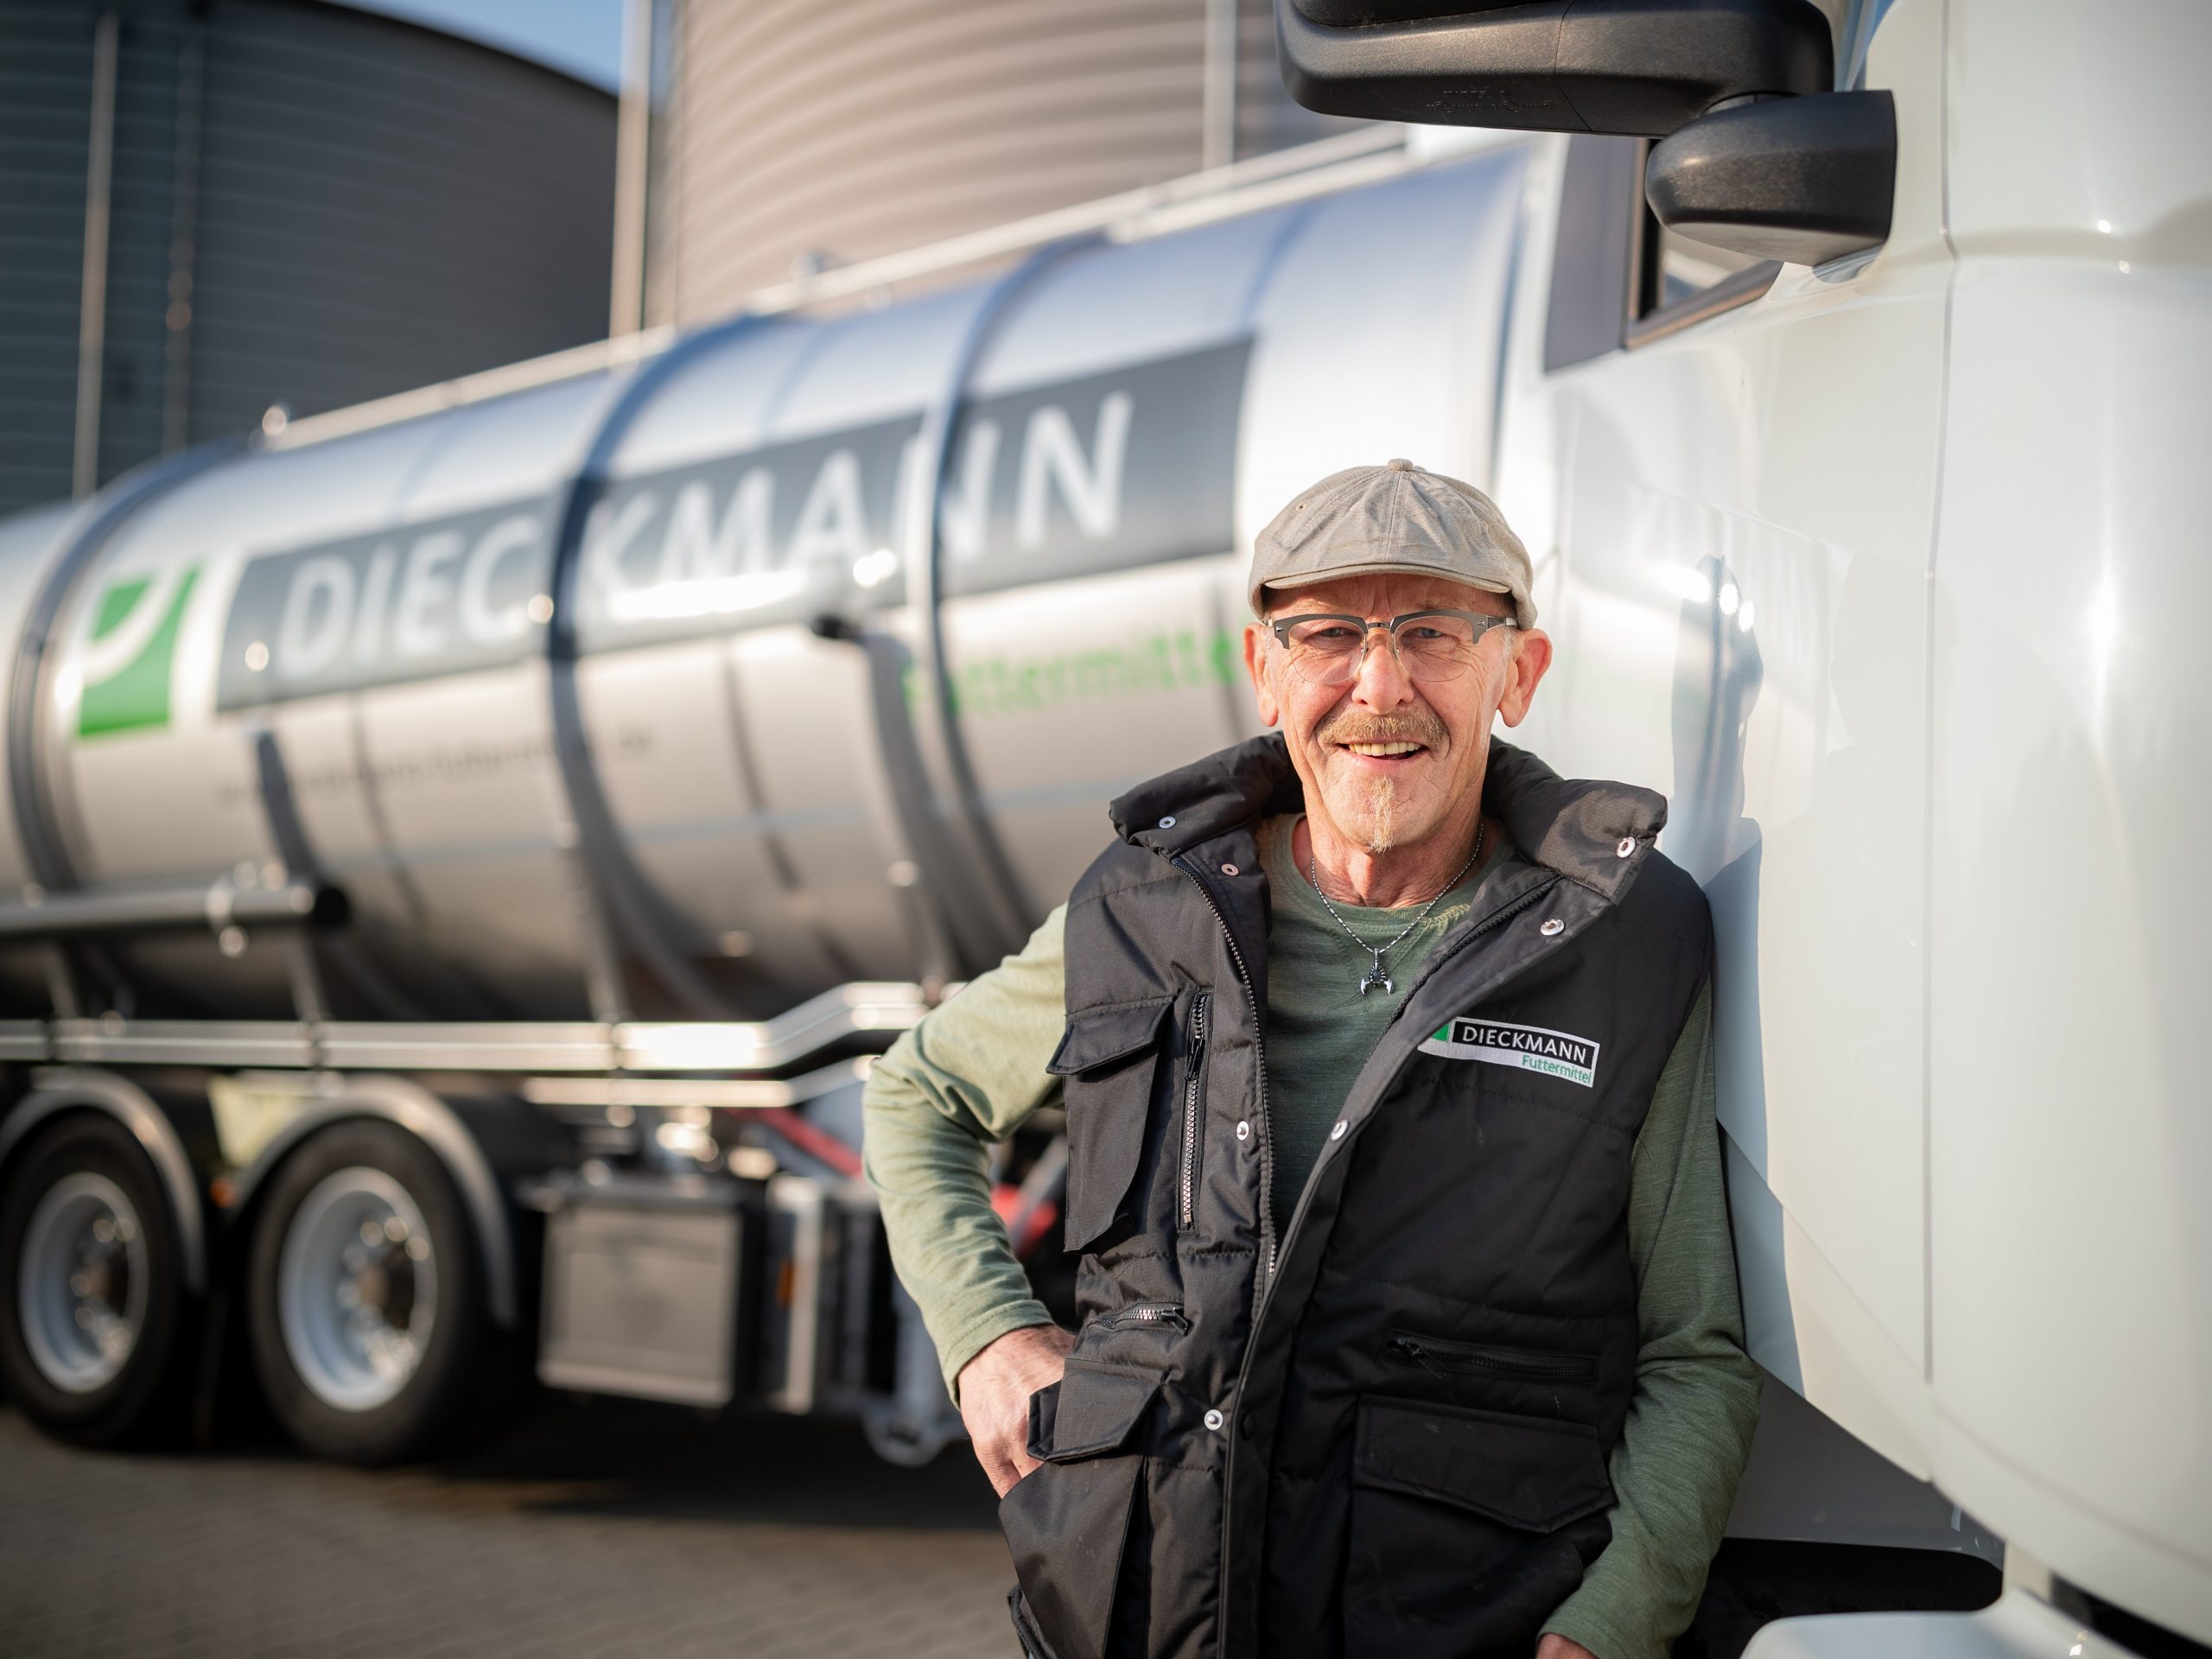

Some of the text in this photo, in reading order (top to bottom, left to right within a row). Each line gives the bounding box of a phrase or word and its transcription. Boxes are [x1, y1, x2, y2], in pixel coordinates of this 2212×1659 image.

[275, 389, 1135, 681] DIECKMANN
[1462, 1026, 1586, 1064] DIECKMANN
[1522, 1054, 1592, 1084] Futtermittel
